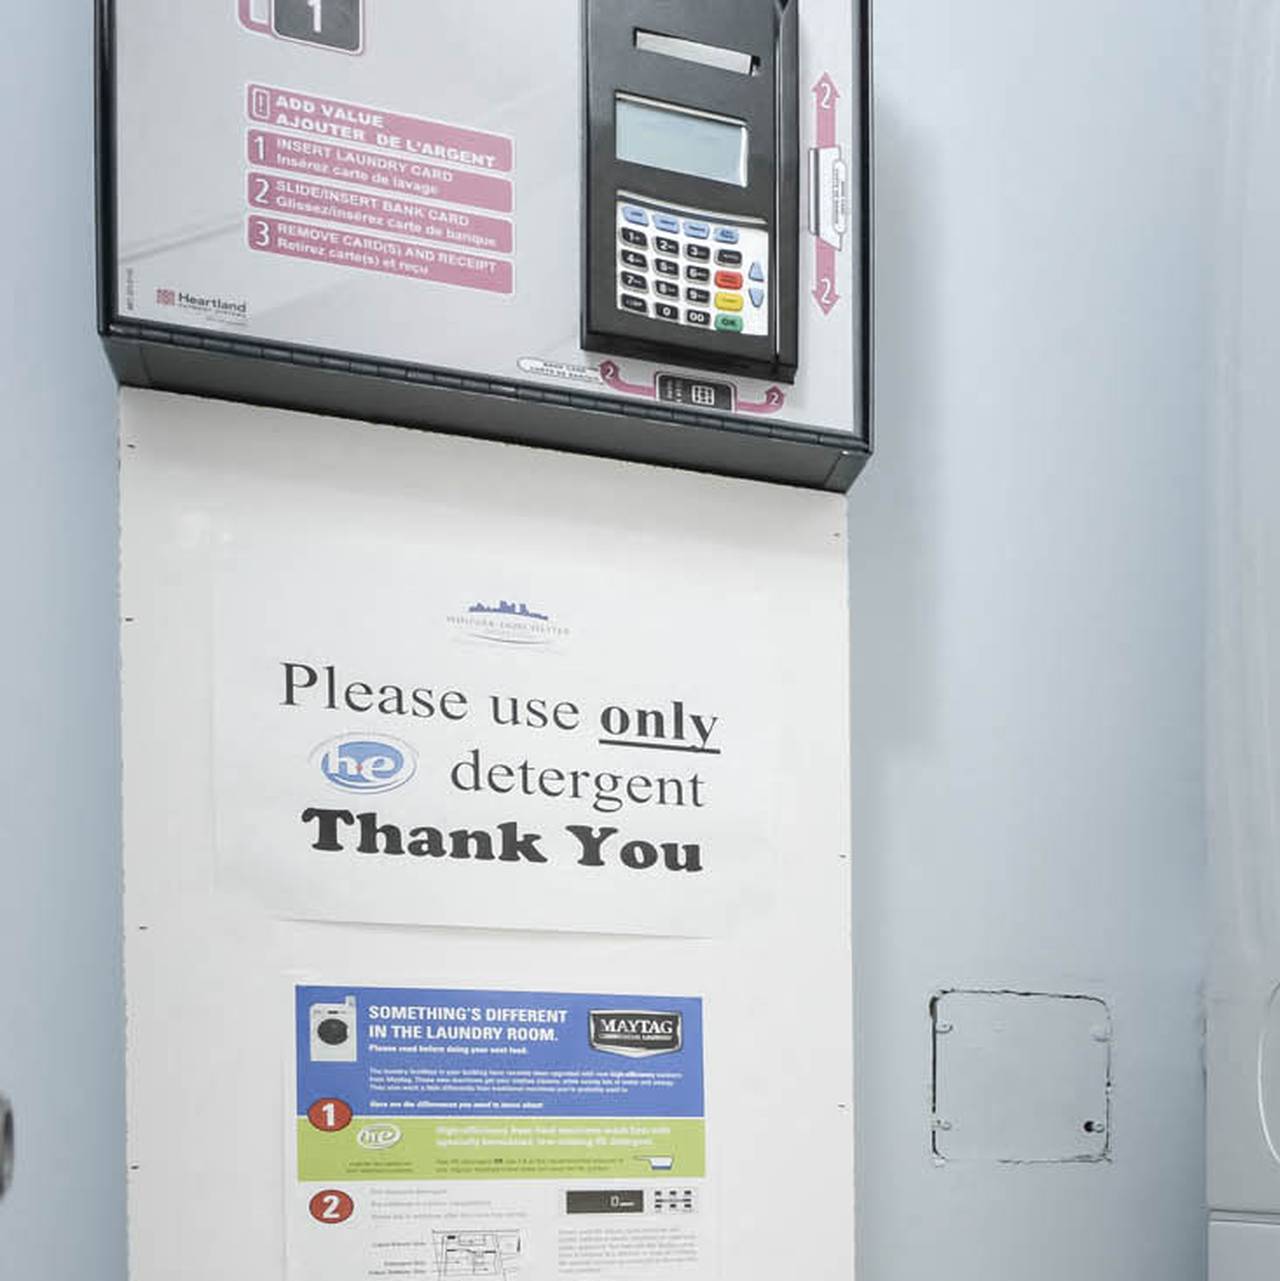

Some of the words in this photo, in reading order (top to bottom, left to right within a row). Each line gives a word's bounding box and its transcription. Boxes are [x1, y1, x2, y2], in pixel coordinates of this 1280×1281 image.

[821, 82, 831, 109] 2
[276, 95, 315, 113] ADD
[321, 104, 384, 128] VALUE
[276, 114, 364, 141] AJOUTER
[376, 134, 401, 148] DE
[406, 140, 496, 168] L'ARGENT
[254, 136, 264, 161] 1
[276, 138, 331, 158] INSERT
[336, 149, 408, 173] LAUNDRY
[410, 165, 453, 182] CARD
[371, 173, 389, 184] de
[255, 179, 269, 204] 2
[276, 181, 377, 208] SLIDE/INSERT
[382, 200, 425, 217] BANK
[428, 210, 469, 226] CARD
[387, 218, 422, 233] carte
[426, 226, 443, 236] de
[446, 229, 497, 247] banque
[255, 220, 270, 246] 3
[277, 224, 340, 244] REMOVE
[343, 234, 401, 255] CARD(S)
[405, 247, 435, 261] AND
[438, 252, 497, 274] RECEIPT
[277, 238, 325, 256] Retirez
[328, 248, 380, 266] carte(s)
[382, 257, 396, 268] et
[178, 292, 247, 314] Heartland
[821, 278, 831, 304] 2
[606, 363, 615, 379] 2
[279, 661, 468, 721] Please
[491, 694, 580, 731] use
[599, 701, 720, 750] only
[326, 744, 398, 783] he
[451, 748, 705, 813] detergent
[301, 807, 548, 864] Thank
[566, 824, 704, 873] You
[368, 1005, 481, 1022] SOMETHING'S
[486, 1008, 568, 1023] DIFFERENT
[600, 1019, 673, 1034] MAYTAG
[369, 1025, 387, 1039] IN
[391, 1025, 422, 1039] THE
[426, 1026, 503, 1040] LAUNDRY
[507, 1027, 559, 1042] ROOM.
[321, 1103, 335, 1127] 1
[322, 1195, 341, 1219] 2
